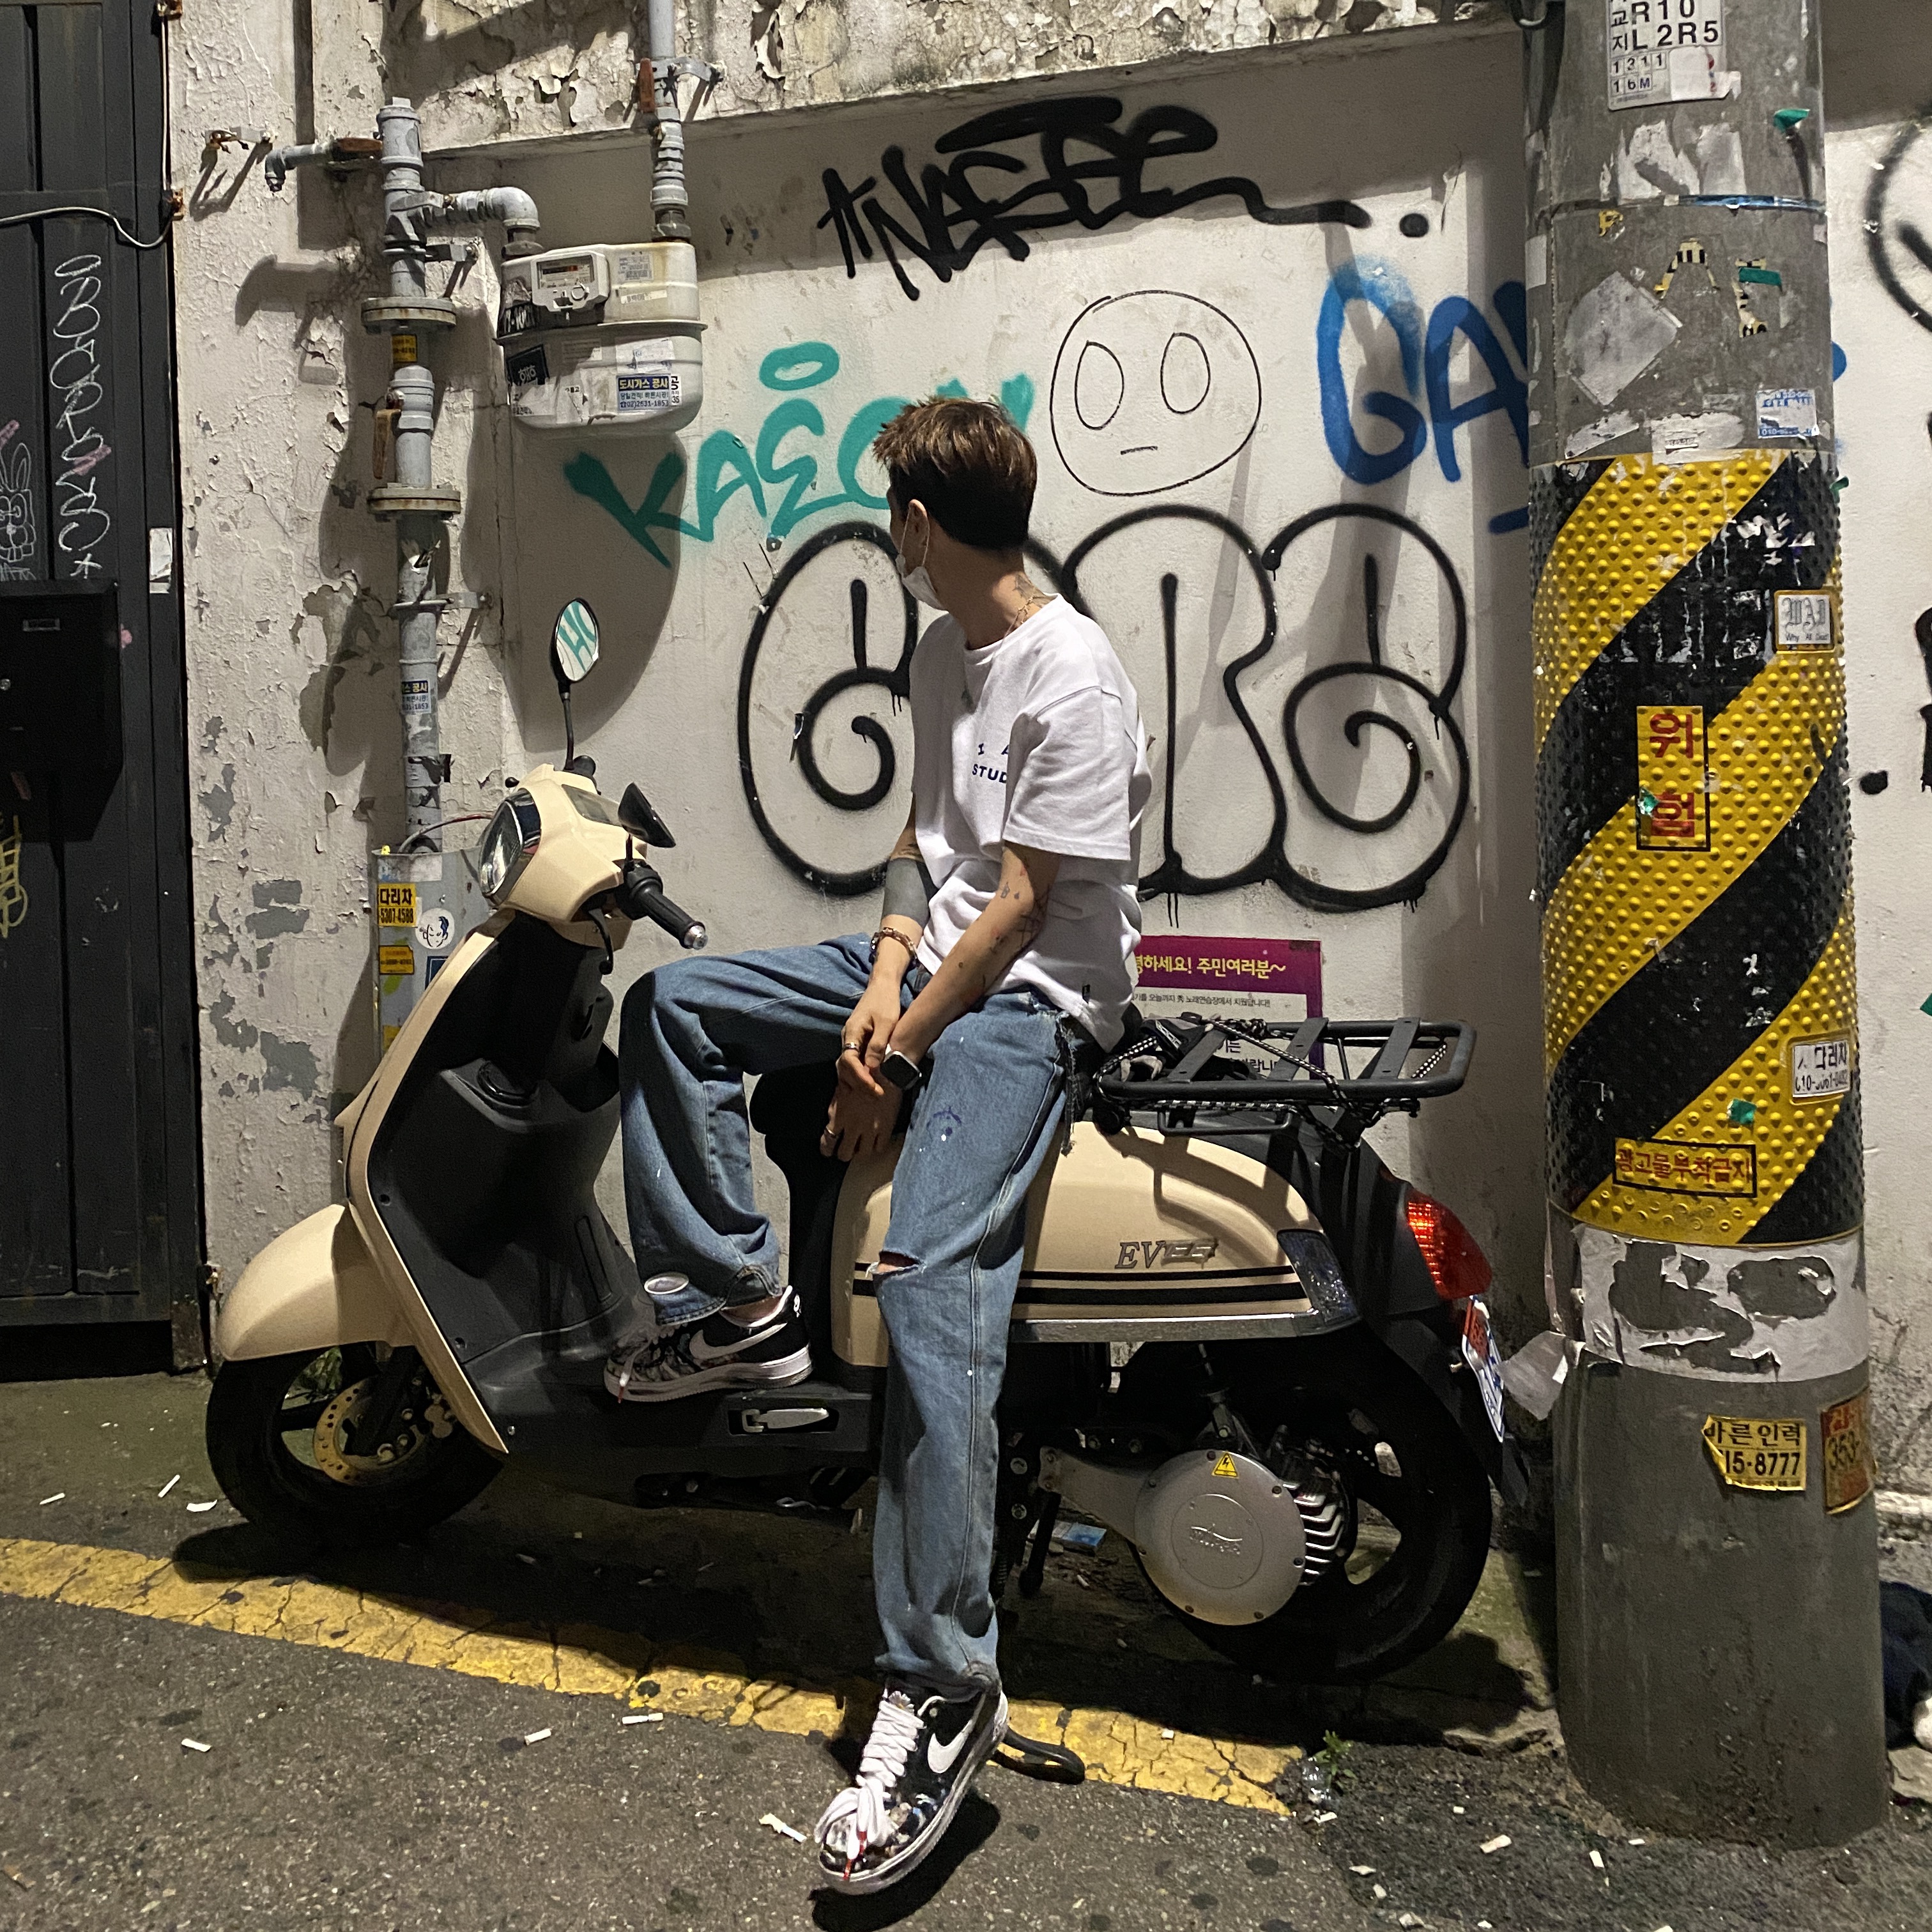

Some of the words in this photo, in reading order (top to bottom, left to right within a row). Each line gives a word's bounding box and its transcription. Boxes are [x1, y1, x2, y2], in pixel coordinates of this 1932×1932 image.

[619, 379, 650, 389] 도시가스
[652, 378, 668, 388] 공사
[1648, 713, 1695, 838] 위험
[1196, 958, 1286, 979] 주민여러분~
